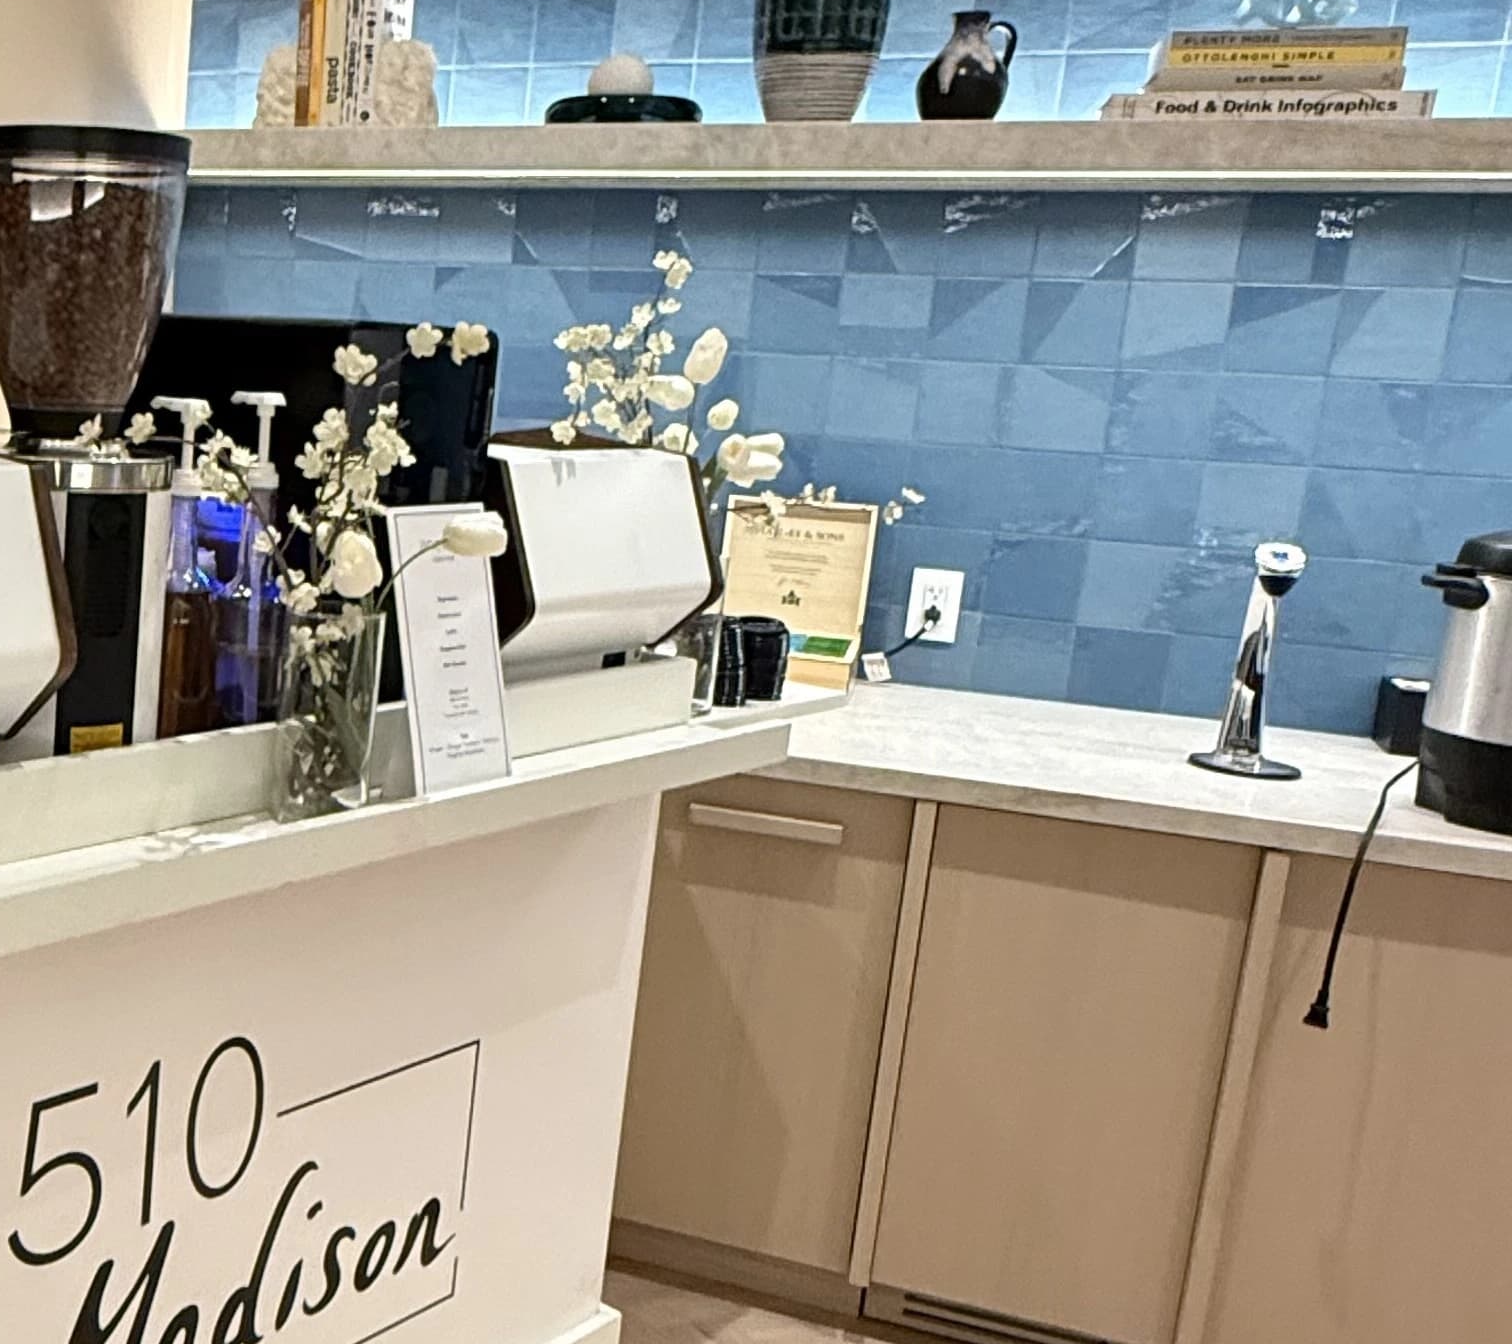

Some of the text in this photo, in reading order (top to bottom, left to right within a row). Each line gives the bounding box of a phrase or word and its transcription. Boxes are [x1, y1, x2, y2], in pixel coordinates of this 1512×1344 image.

[1182, 51, 1335, 62] OTTOLENGHI SIMPLE
[326, 57, 339, 104] pasta
[1155, 98, 1398, 115] Food & Drink Infographics
[7, 1036, 264, 1266] 510
